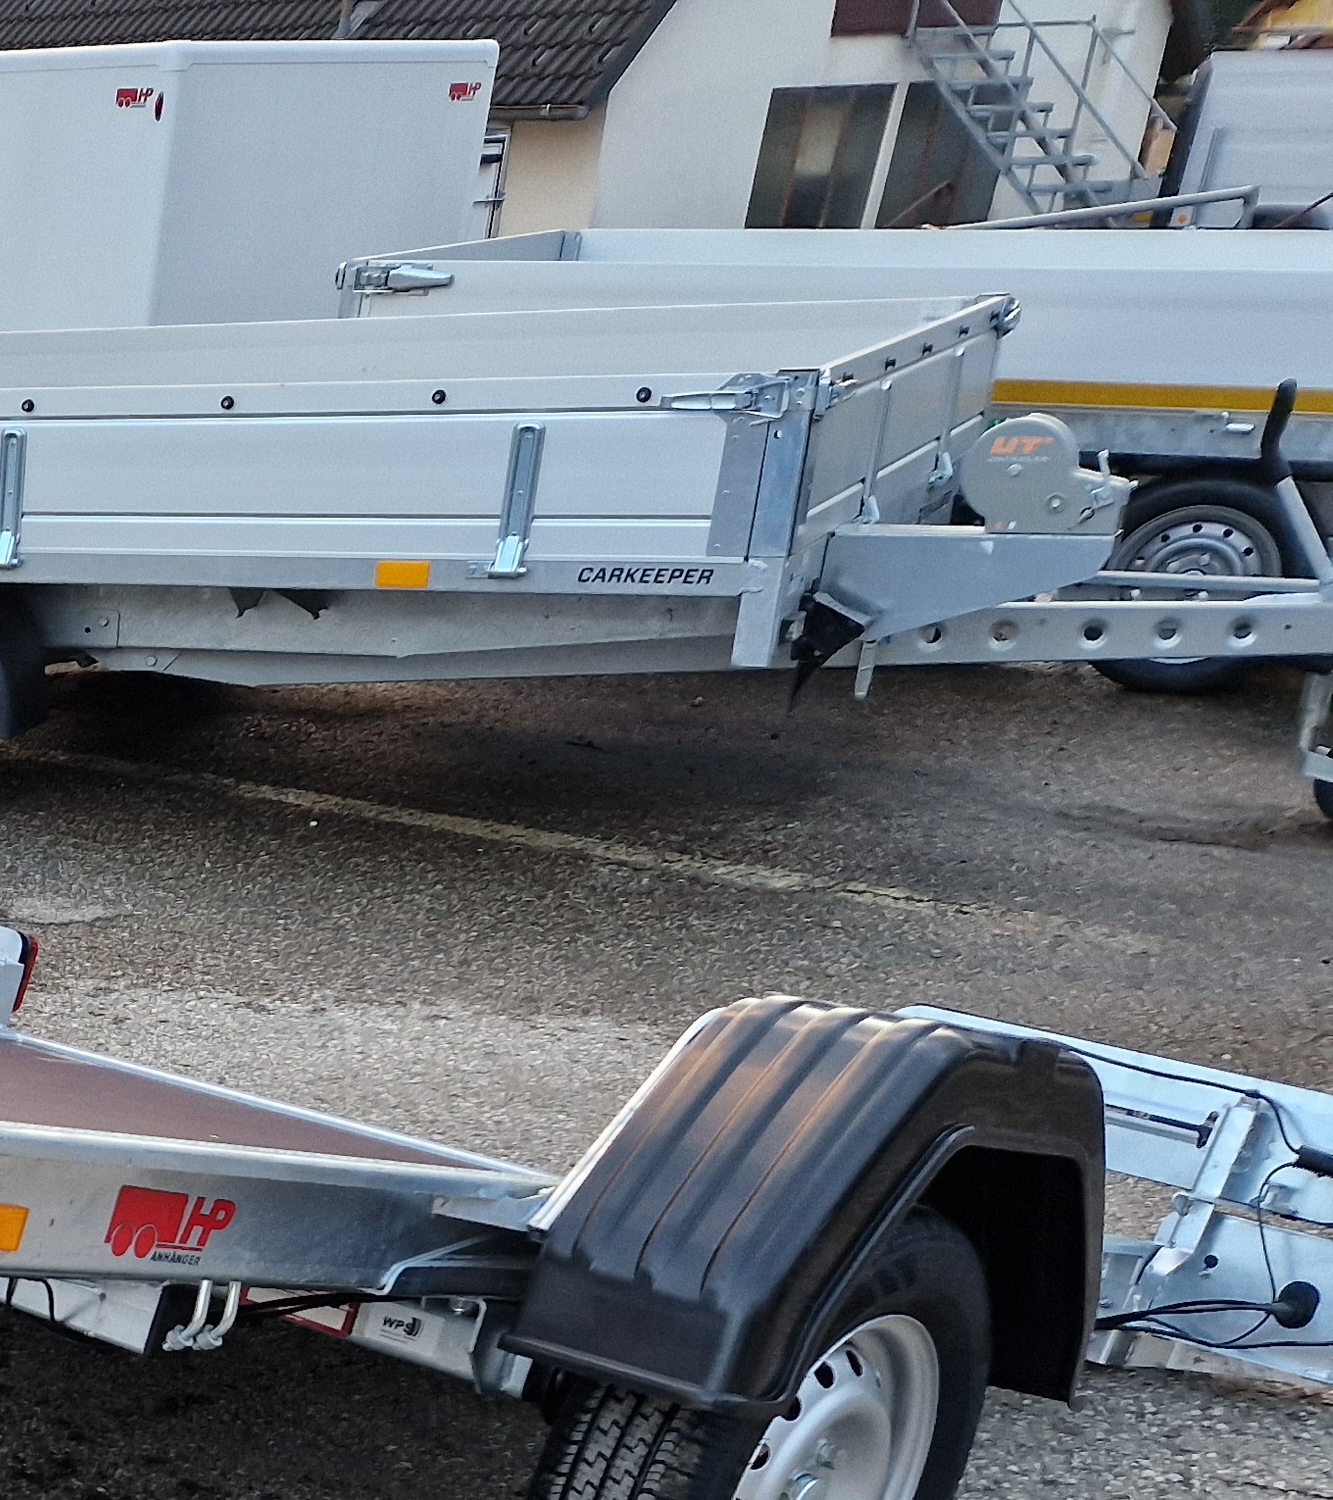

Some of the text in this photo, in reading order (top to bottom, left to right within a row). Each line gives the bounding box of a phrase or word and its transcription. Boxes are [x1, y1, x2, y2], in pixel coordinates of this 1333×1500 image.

[137, 86, 154, 103] HP
[577, 566, 715, 585] CARKEEPER
[178, 1195, 237, 1247] HP
[150, 1250, 201, 1266] ANHÄNGER
